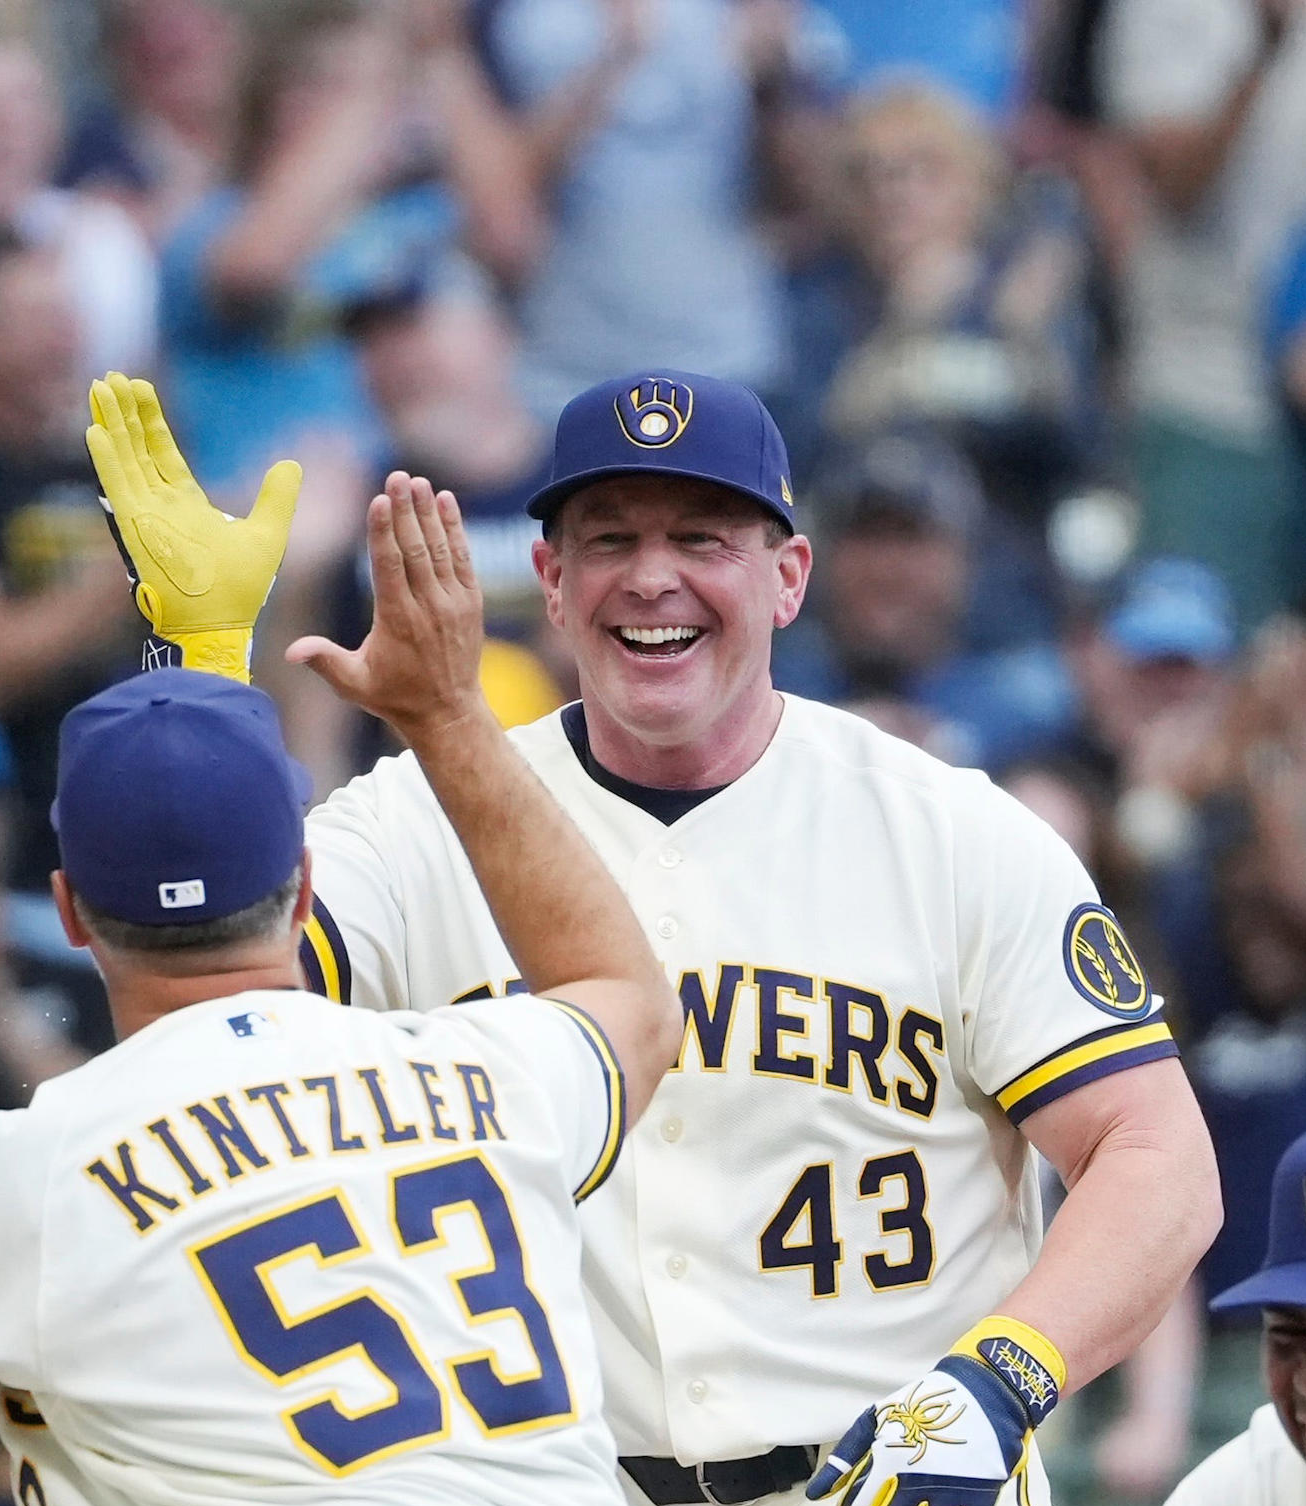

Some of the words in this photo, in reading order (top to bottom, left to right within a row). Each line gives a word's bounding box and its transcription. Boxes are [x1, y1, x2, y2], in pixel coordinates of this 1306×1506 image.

[82, 1060, 508, 1239] KINTZLER
[757, 1147, 937, 1299] 43
[186, 1148, 577, 1479] 53
